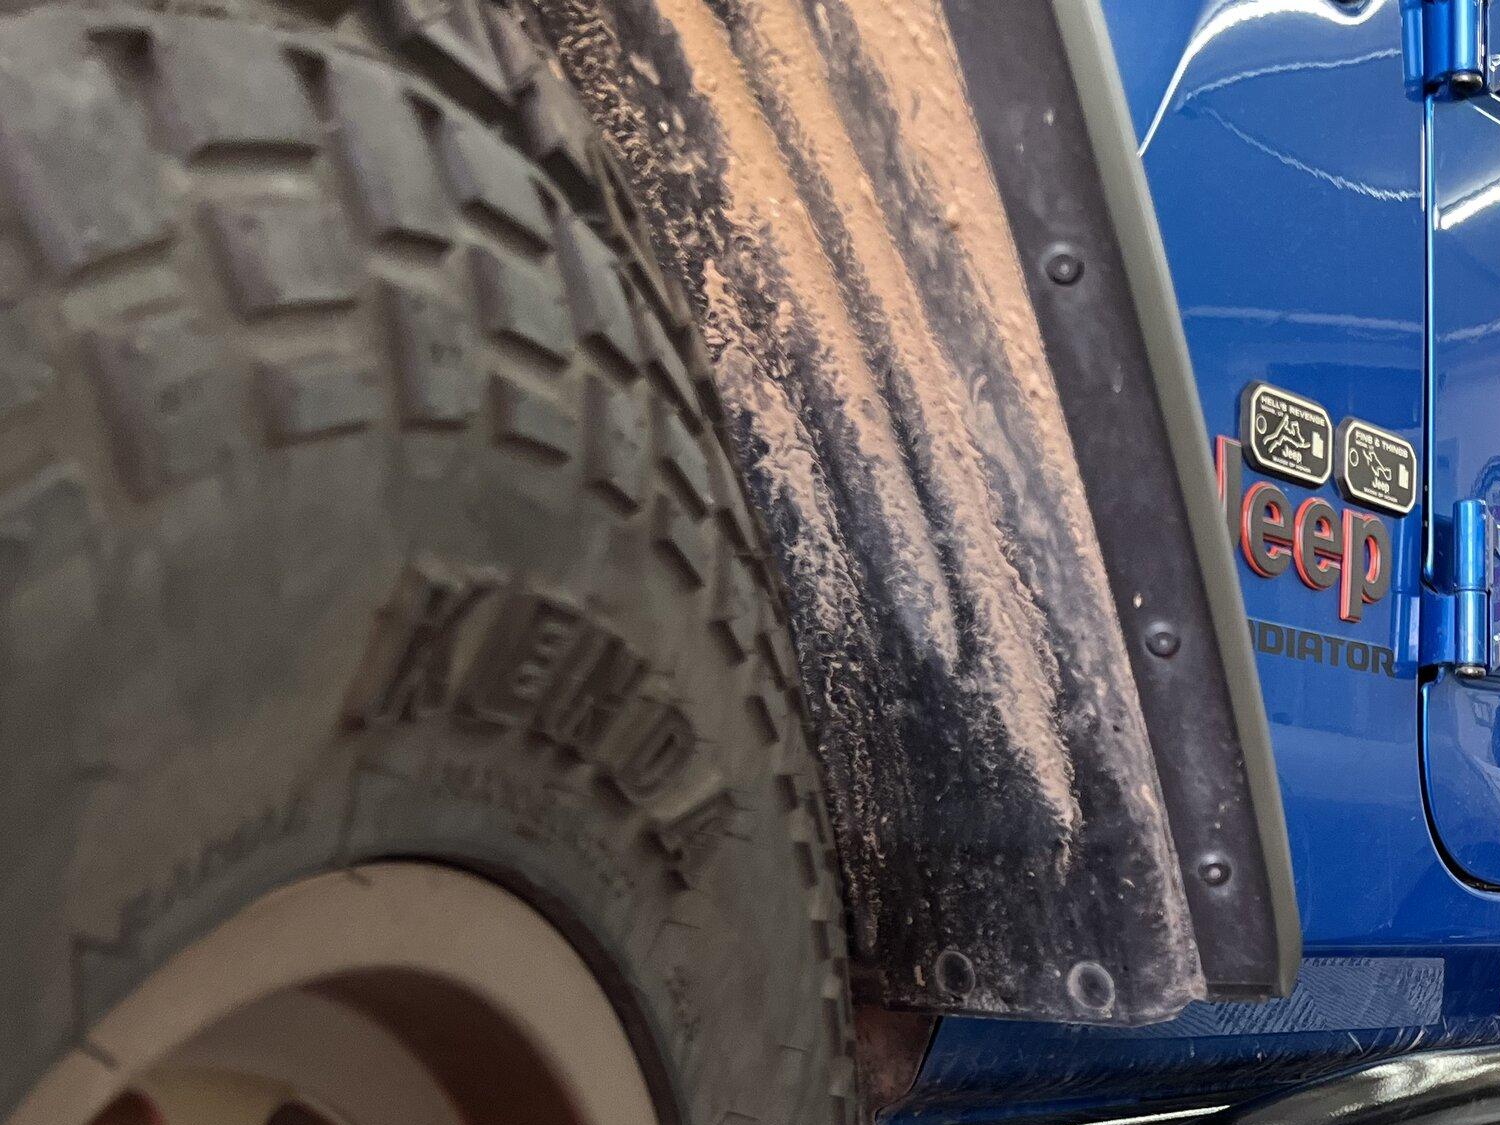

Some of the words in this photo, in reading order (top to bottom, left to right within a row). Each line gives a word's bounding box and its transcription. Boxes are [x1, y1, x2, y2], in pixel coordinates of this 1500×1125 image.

[1260, 396, 1288, 412] HELL'S
[1289, 405, 1325, 427] REVENGE
[1282, 445, 1303, 465] Jeep
[1382, 440, 1409, 459] THINGS
[1371, 478, 1390, 494] Jeep
[1249, 620, 1396, 677] DIATOR
[338, 555, 738, 892] KENDA
